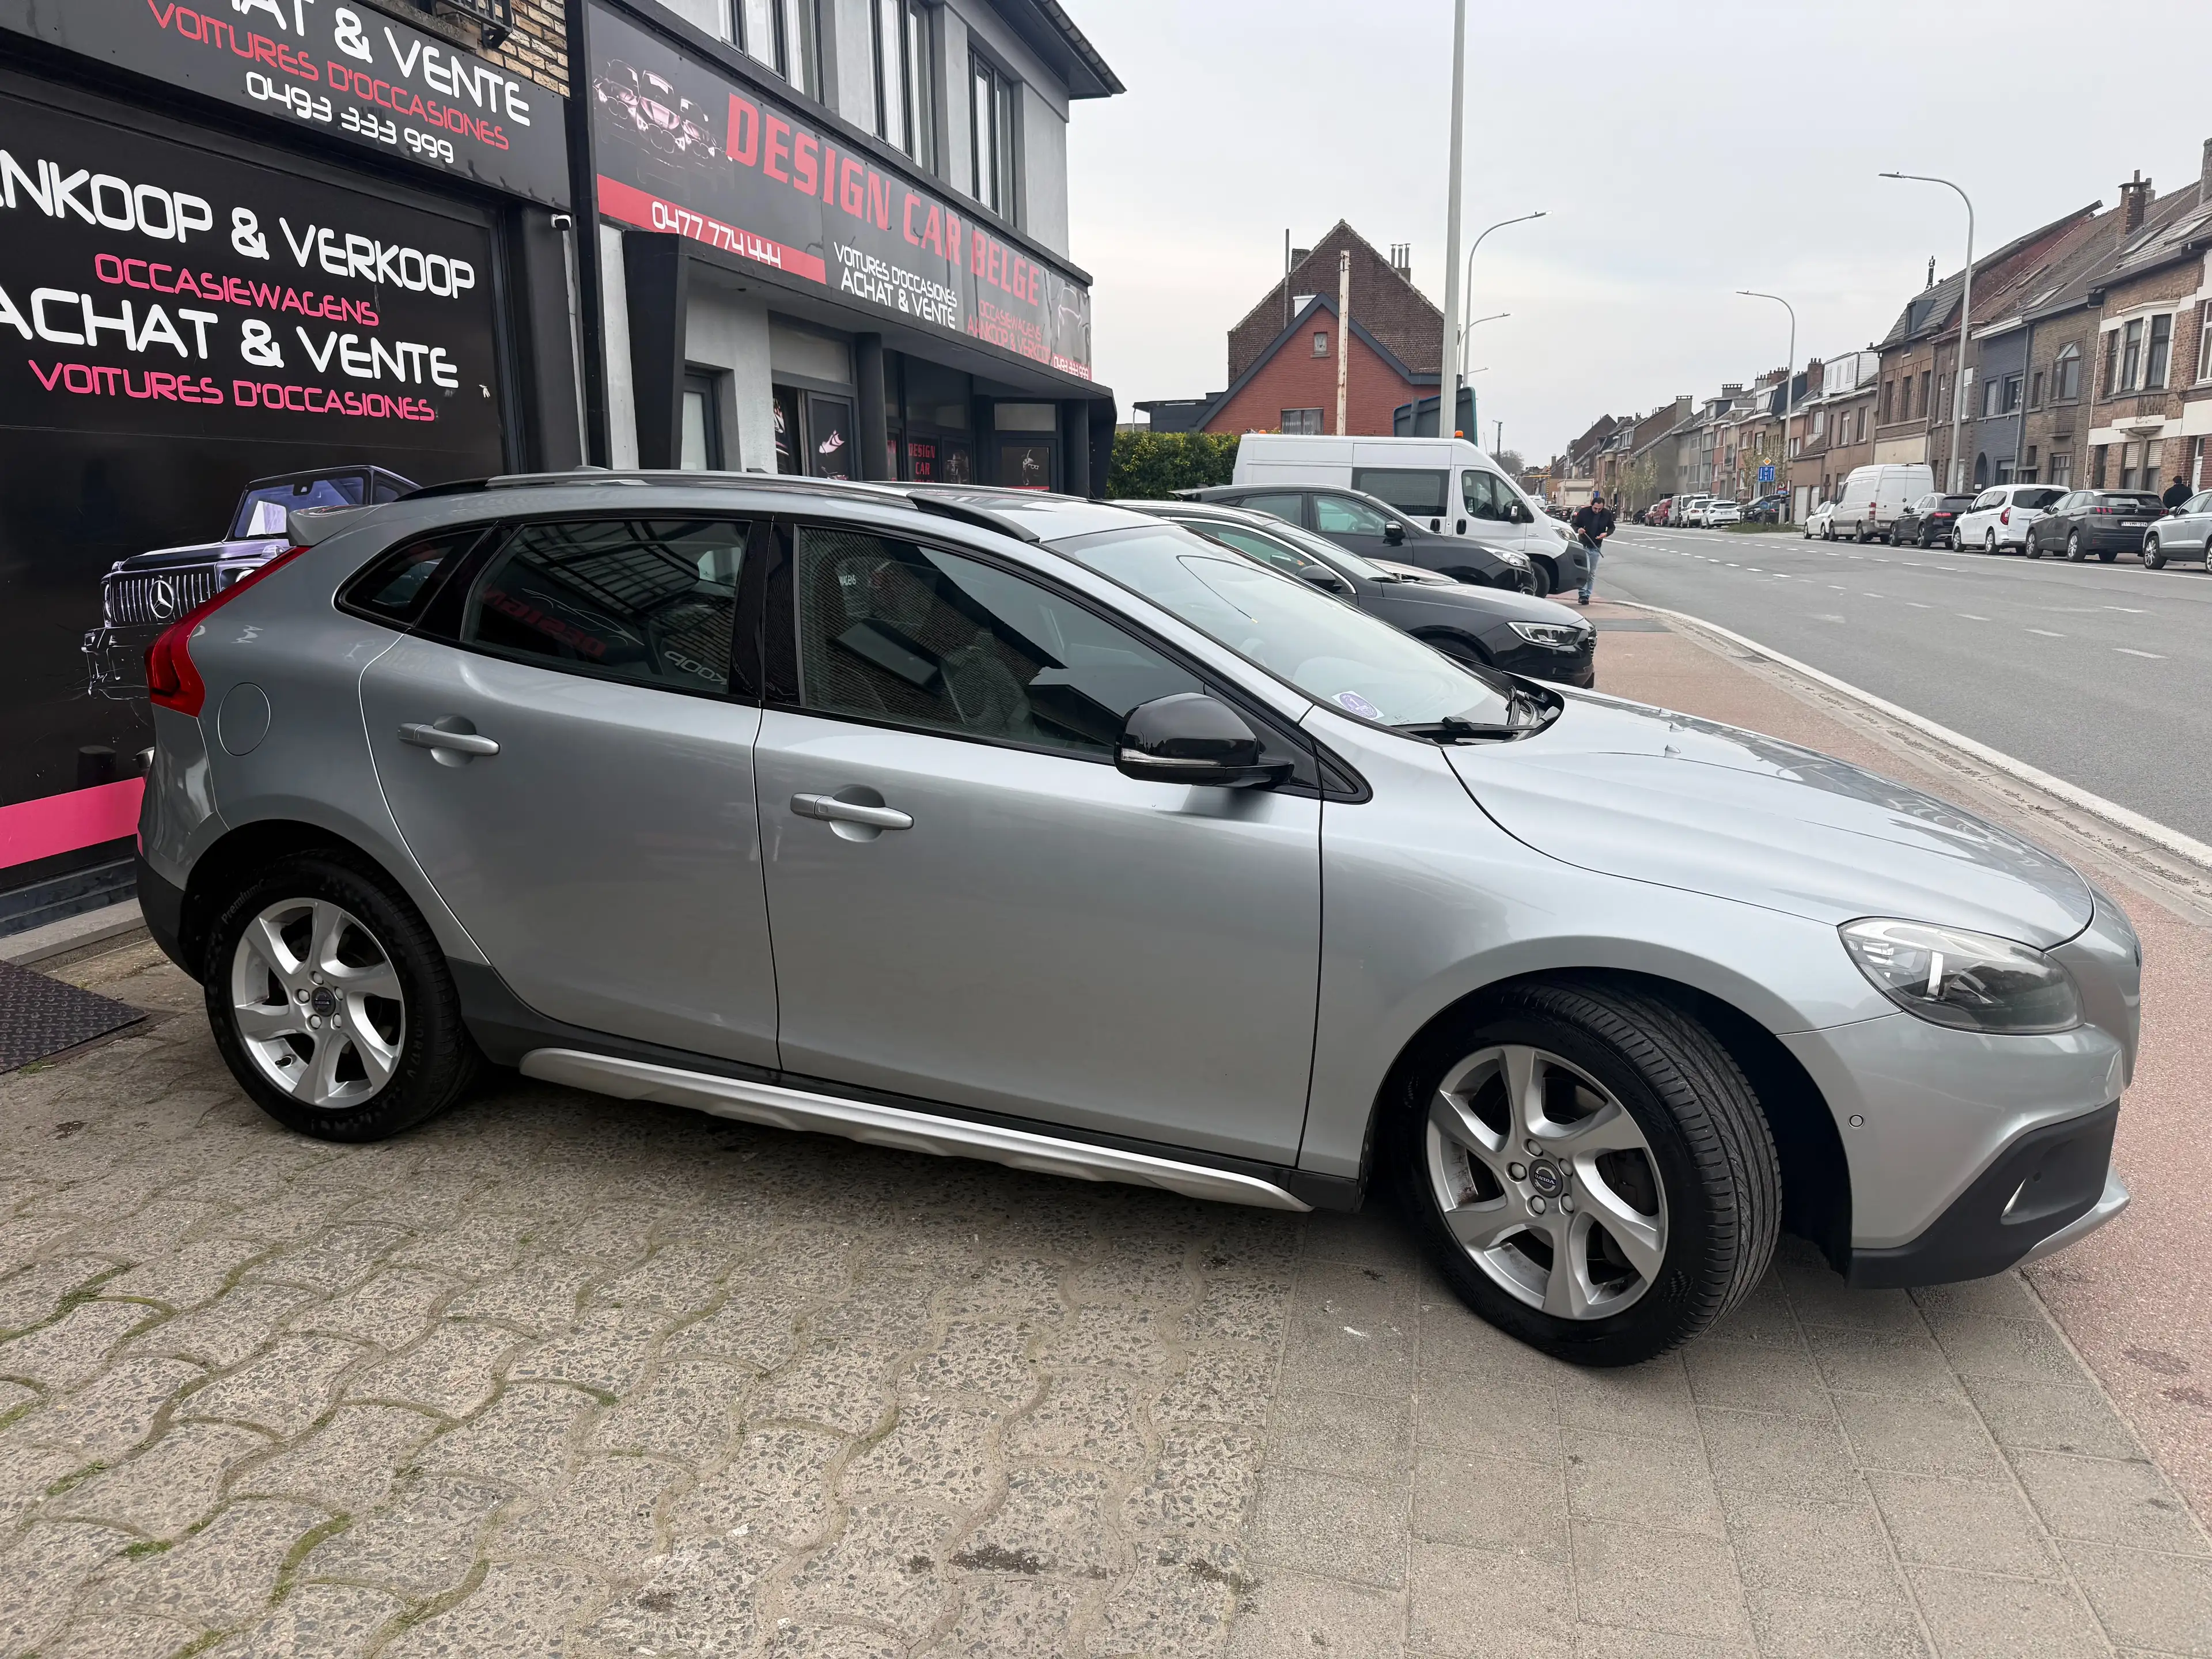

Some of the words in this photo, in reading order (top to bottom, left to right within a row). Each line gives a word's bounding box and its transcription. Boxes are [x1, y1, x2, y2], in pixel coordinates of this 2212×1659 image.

[147, 0, 319, 81] VOITURES
[327, 60, 509, 150] D'OCCASIONES
[334, 7, 373, 63] &
[384, 26, 531, 127] VENTE
[245, 71, 332, 122] 0493
[340, 107, 397, 145] 333
[404, 128, 454, 164] 999
[0, 149, 213, 243] NKOOP
[231, 207, 270, 260] &
[279, 217, 475, 299] VERKOOP
[725, 92, 891, 231] DESIGN
[903, 192, 961, 266] CAR
[971, 228, 1039, 306] BELGE
[652, 201, 703, 240] 0477
[708, 222, 744, 256] 774
[748, 235, 782, 268] 444
[95, 253, 379, 326] OCCASIEWAGENS
[834, 241, 889, 281] VOITURES
[892, 266, 957, 308] D'OCCASIONES
[841, 267, 893, 306] ACHAT
[898, 289, 909, 313] &
[911, 296, 956, 329] VENTE
[241, 319, 285, 368] &
[296, 325, 459, 388] VENTE
[967, 313, 1008, 347] AANKOOP
[28, 359, 224, 404] VOITURES
[233, 380, 435, 421] D'OCCASIONES
[908, 443, 935, 459] DESIGN
[915, 461, 930, 475] CAR
